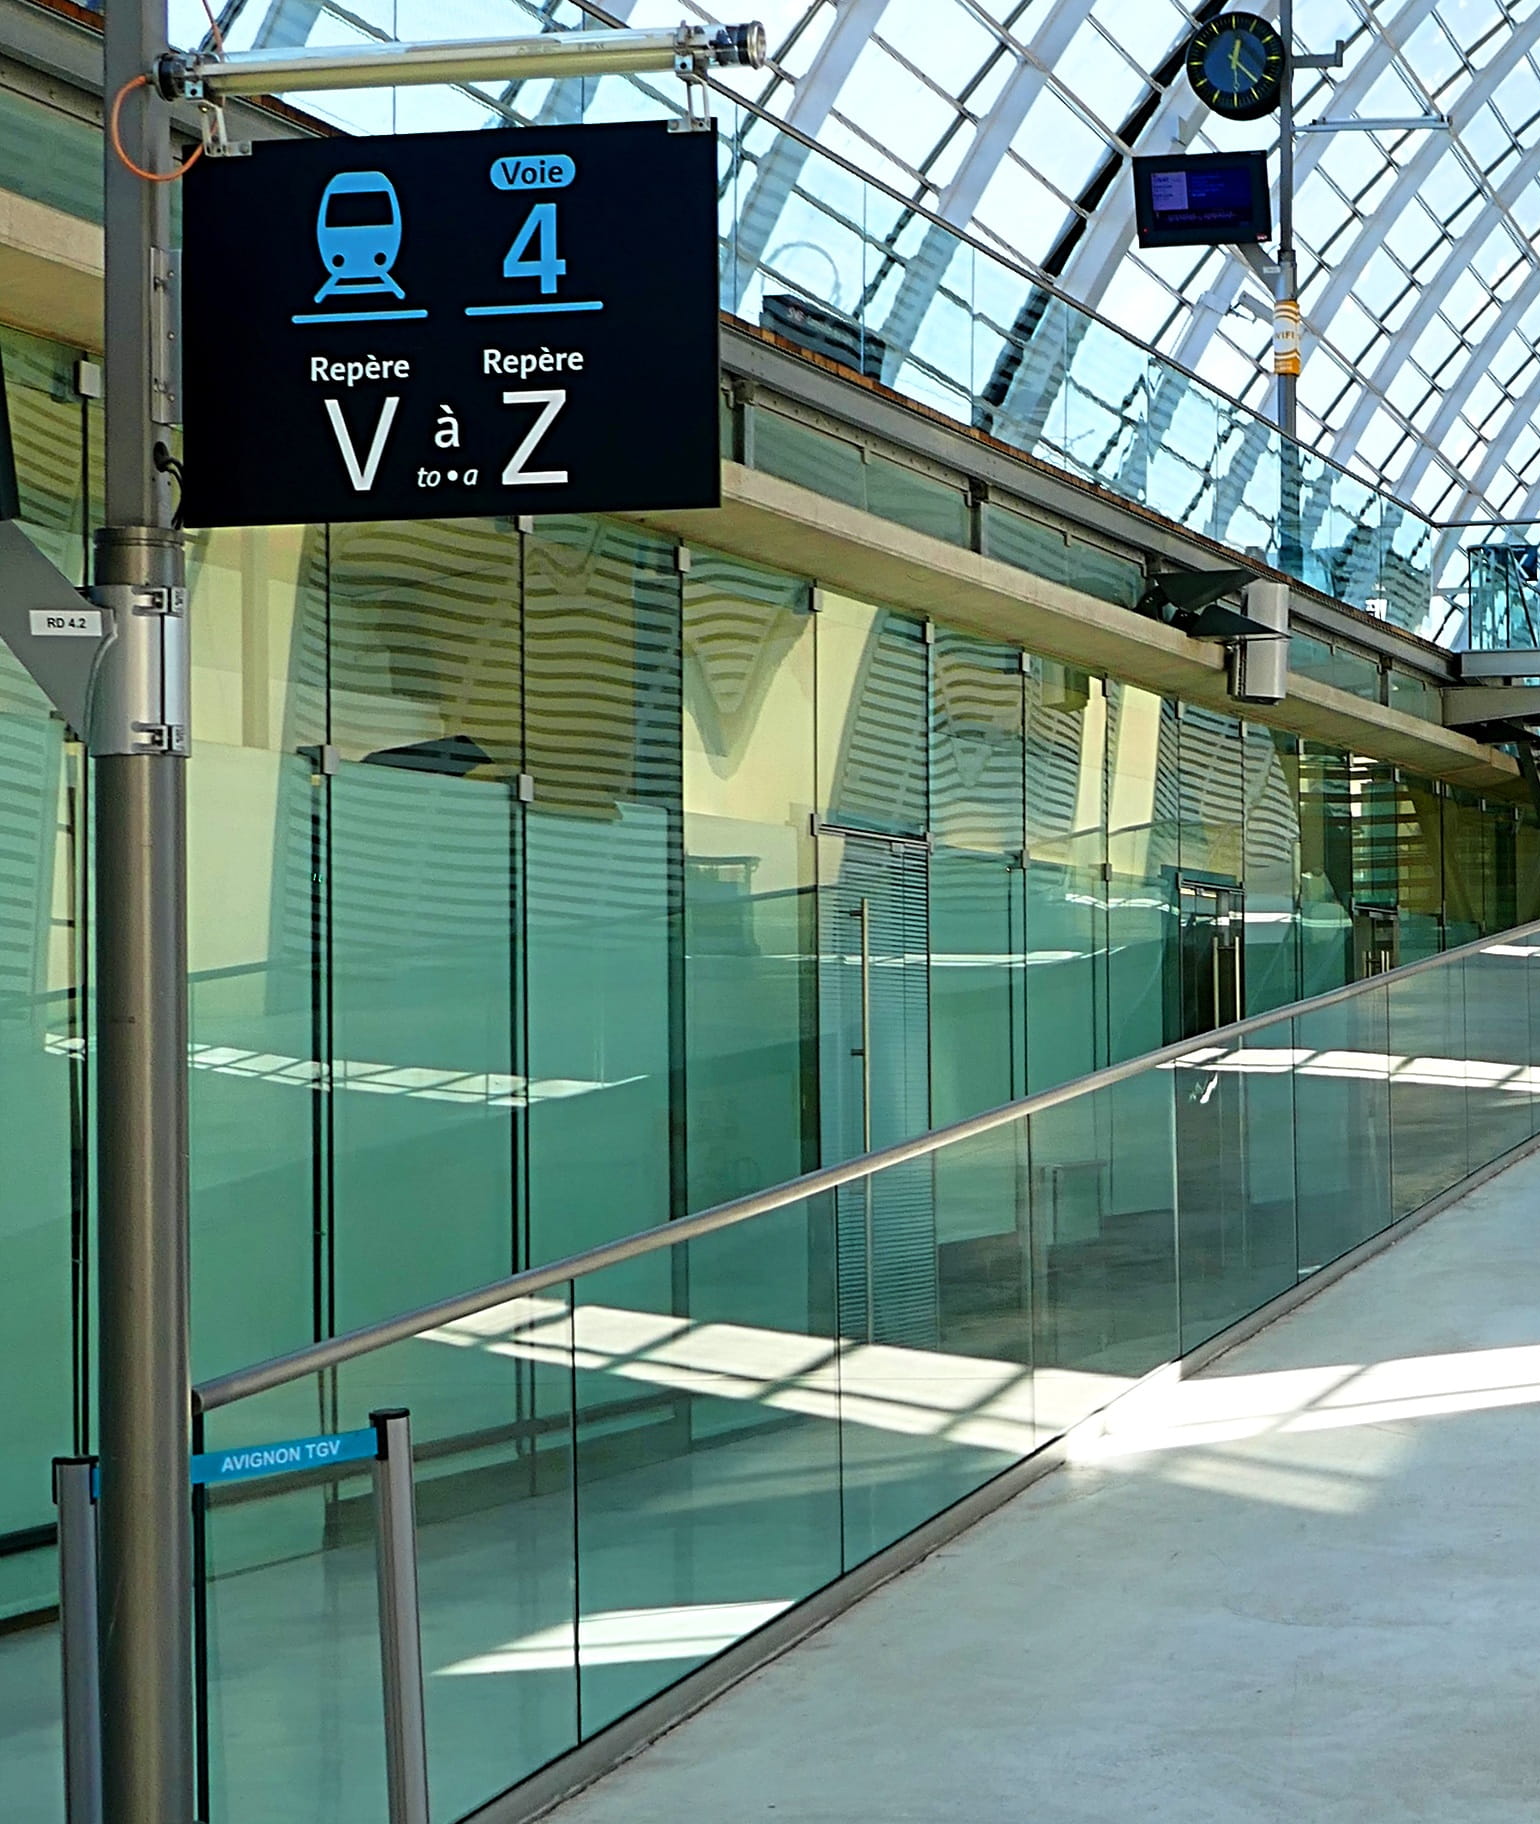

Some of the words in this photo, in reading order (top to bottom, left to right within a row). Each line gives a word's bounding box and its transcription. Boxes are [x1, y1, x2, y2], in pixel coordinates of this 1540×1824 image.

[500, 159, 564, 185] Voie
[503, 202, 567, 295] 4
[310, 354, 410, 387] Repère
[483, 346, 584, 380] Repère
[324, 396, 400, 491] V
[434, 404, 460, 449] à
[501, 389, 569, 486] Z
[417, 467, 441, 488] to
[463, 468, 479, 486] a
[46, 617, 65, 629] RD
[68, 617, 87, 629] 4.2
[221, 1446, 300, 1473] AVIGNON
[305, 1440, 341, 1459] TGV
